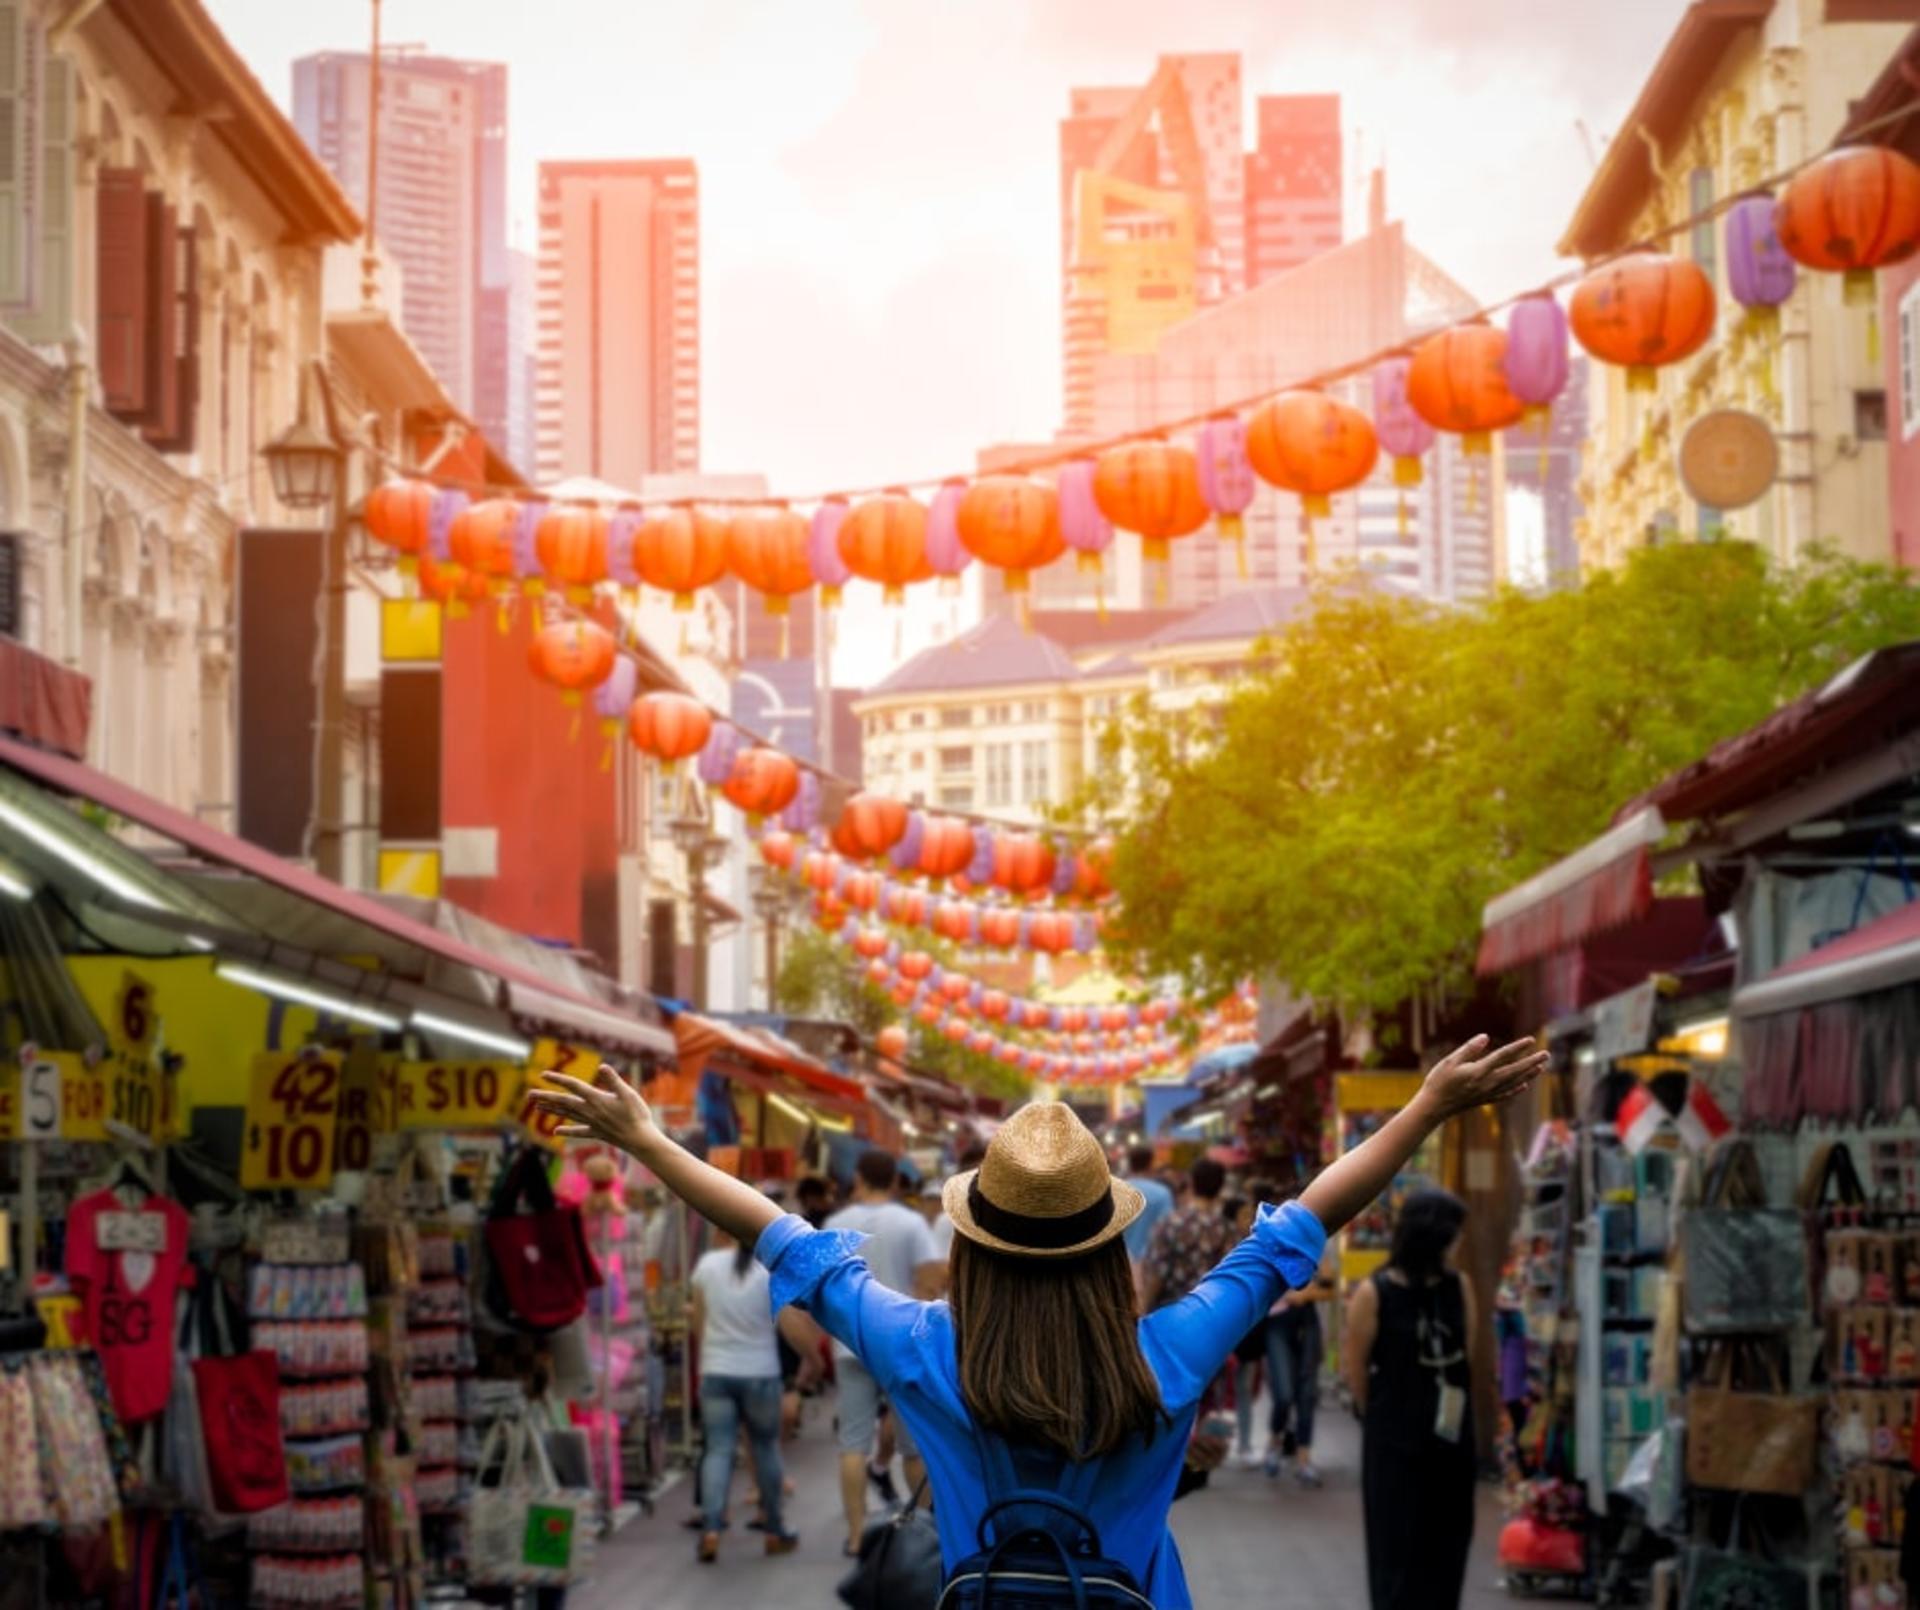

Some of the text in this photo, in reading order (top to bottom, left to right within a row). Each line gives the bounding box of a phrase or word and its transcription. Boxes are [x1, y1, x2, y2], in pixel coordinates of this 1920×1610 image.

[124, 984, 146, 1041] 6
[31, 1062, 57, 1129] 5
[272, 1061, 336, 1121] 42
[427, 1066, 498, 1111] $10
[101, 1299, 153, 1346] SG
